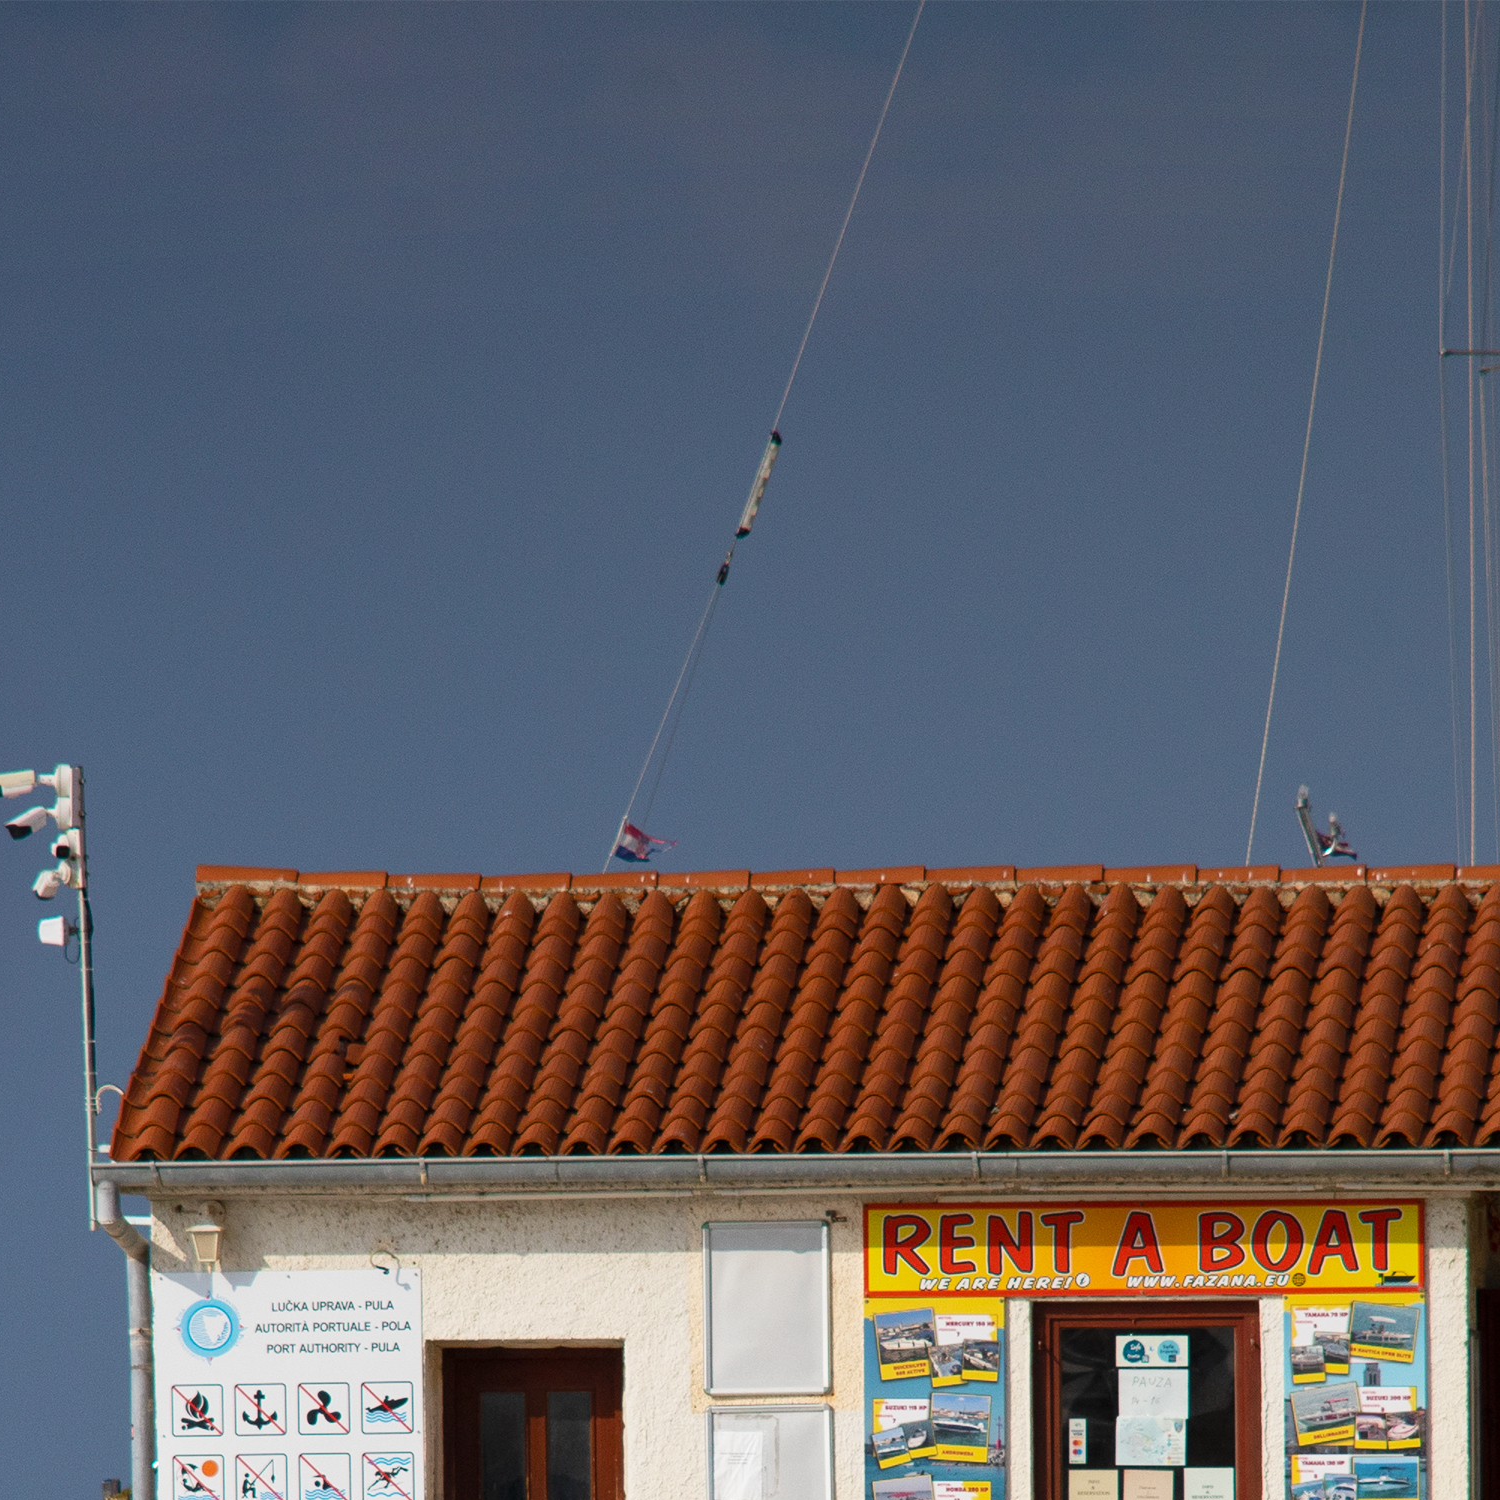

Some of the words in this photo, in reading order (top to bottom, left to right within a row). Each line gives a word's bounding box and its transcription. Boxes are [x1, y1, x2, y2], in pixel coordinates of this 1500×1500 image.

[882, 1210, 1085, 1277] RENT
[1111, 1210, 1164, 1278] A
[1199, 1208, 1403, 1277] BOAT
[919, 1278, 942, 1291] WE
[955, 1277, 999, 1290] ARE
[1006, 1275, 1073, 1290] HERE!
[1126, 1273, 1290, 1288] WWW.FAZANA.EU
[271, 1300, 309, 1312] LUČKA
[312, 1301, 355, 1312] UPRAVA
[365, 1300, 394, 1311] PULA
[254, 1320, 309, 1333] AUTORITÀ
[312, 1321, 371, 1333] PORTUALE
[382, 1321, 411, 1331] POLA
[266, 1344, 295, 1354] PORT
[299, 1343, 361, 1354] AUTHORITY
[371, 1342, 401, 1353] PULA
